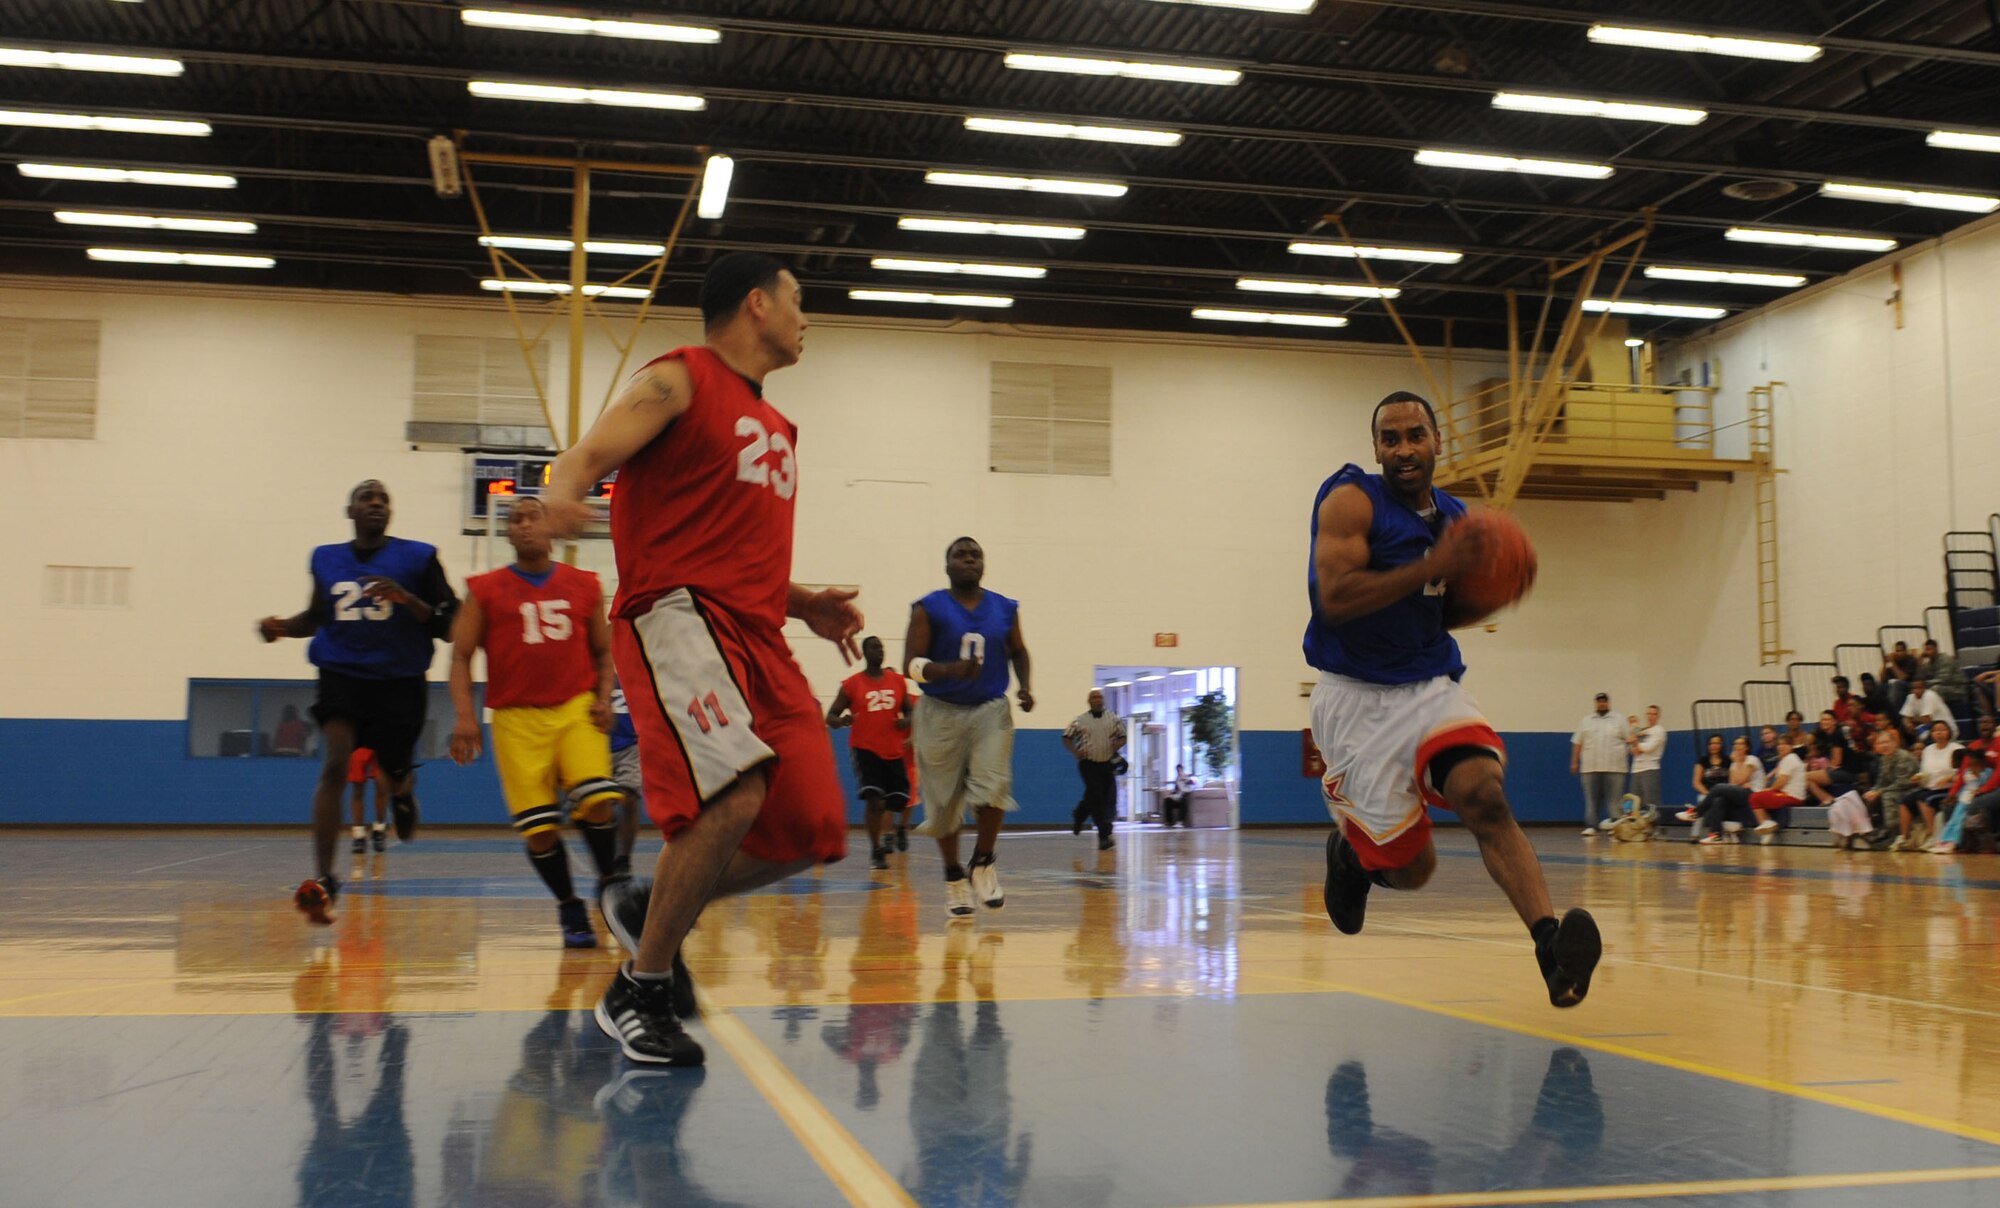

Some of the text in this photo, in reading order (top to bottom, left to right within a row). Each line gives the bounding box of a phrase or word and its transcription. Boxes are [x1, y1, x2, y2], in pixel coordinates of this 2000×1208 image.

[735, 416, 796, 500] 23
[331, 581, 393, 620] 23
[519, 599, 573, 644] 15
[687, 689, 729, 734] 11
[865, 690, 896, 711] 25
